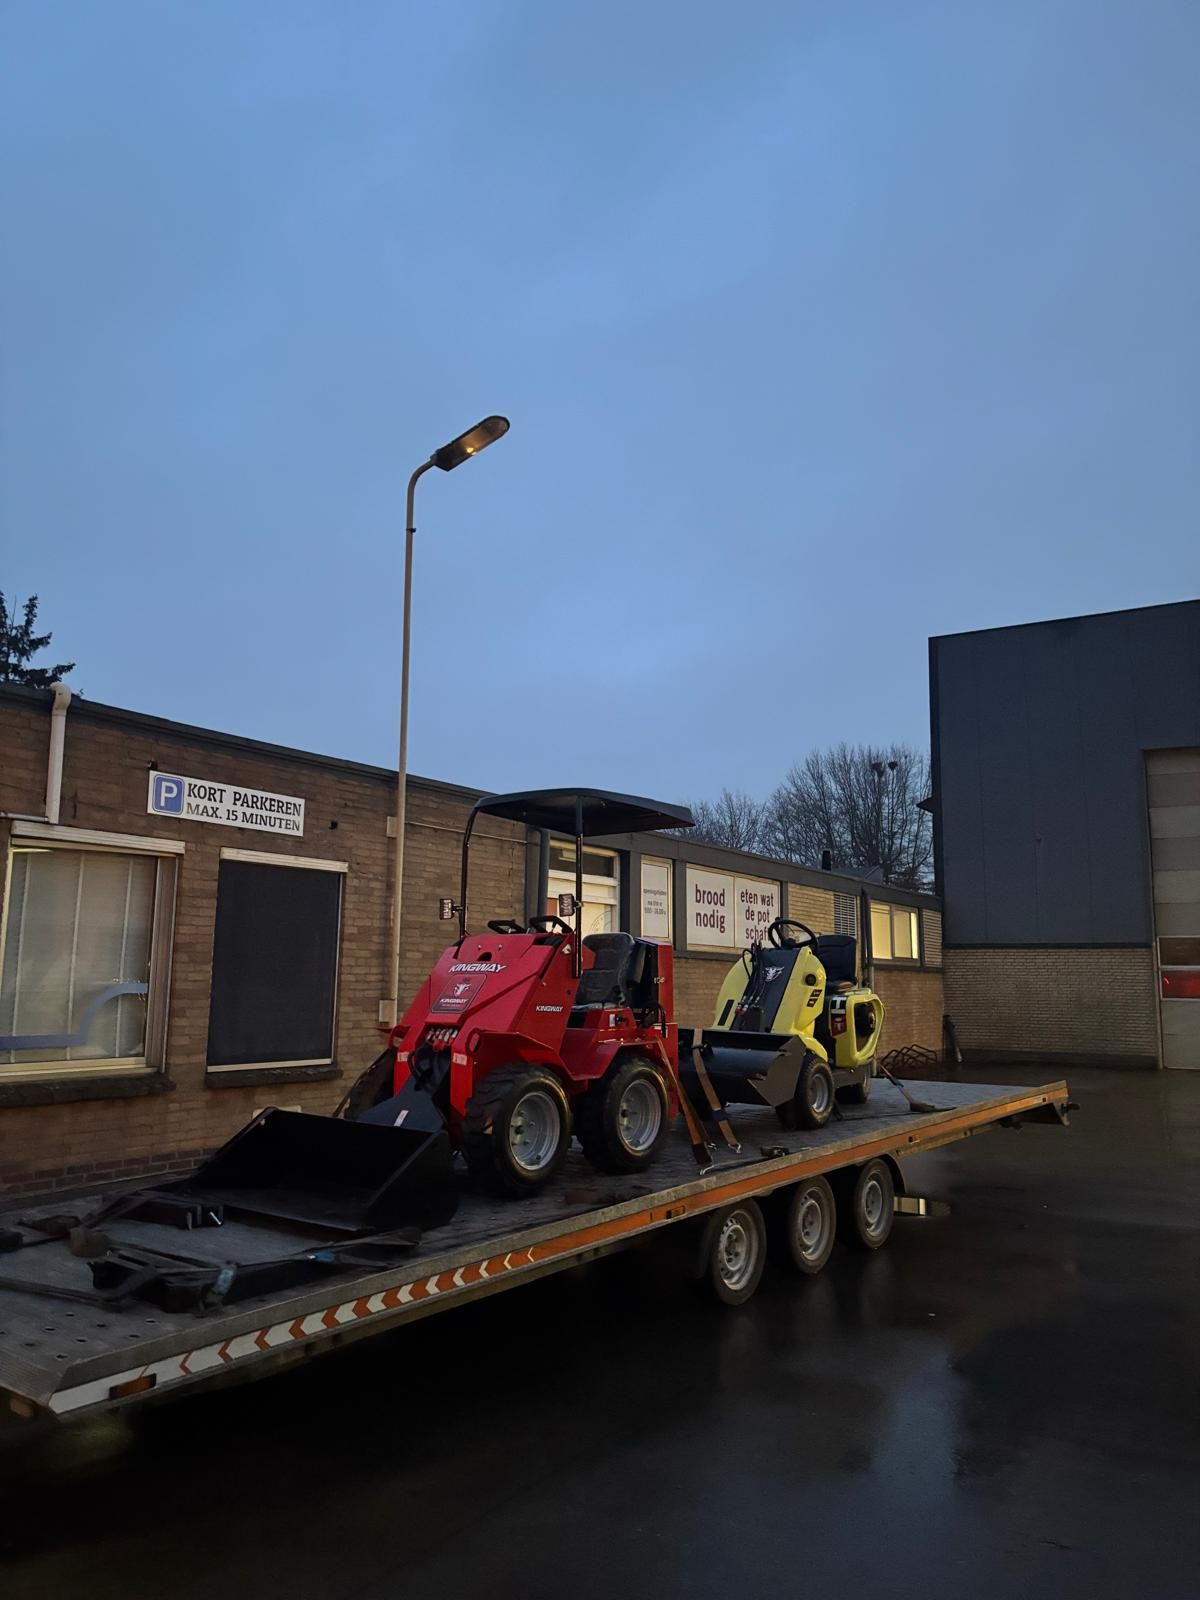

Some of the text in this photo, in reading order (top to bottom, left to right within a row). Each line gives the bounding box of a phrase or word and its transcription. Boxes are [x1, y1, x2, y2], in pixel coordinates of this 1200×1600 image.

[187, 782, 302, 817] KORT PARKEREN
[186, 802, 301, 832] MAX. 15 MINUTEN
[695, 883, 726, 907] brood
[740, 888, 774, 907] eten wat
[695, 909, 726, 934] nodig
[745, 905, 770, 925] de pot
[745, 925, 769, 941] schaf
[448, 963, 507, 973] KINGWAY
[535, 1005, 564, 1013] KINGWAY
